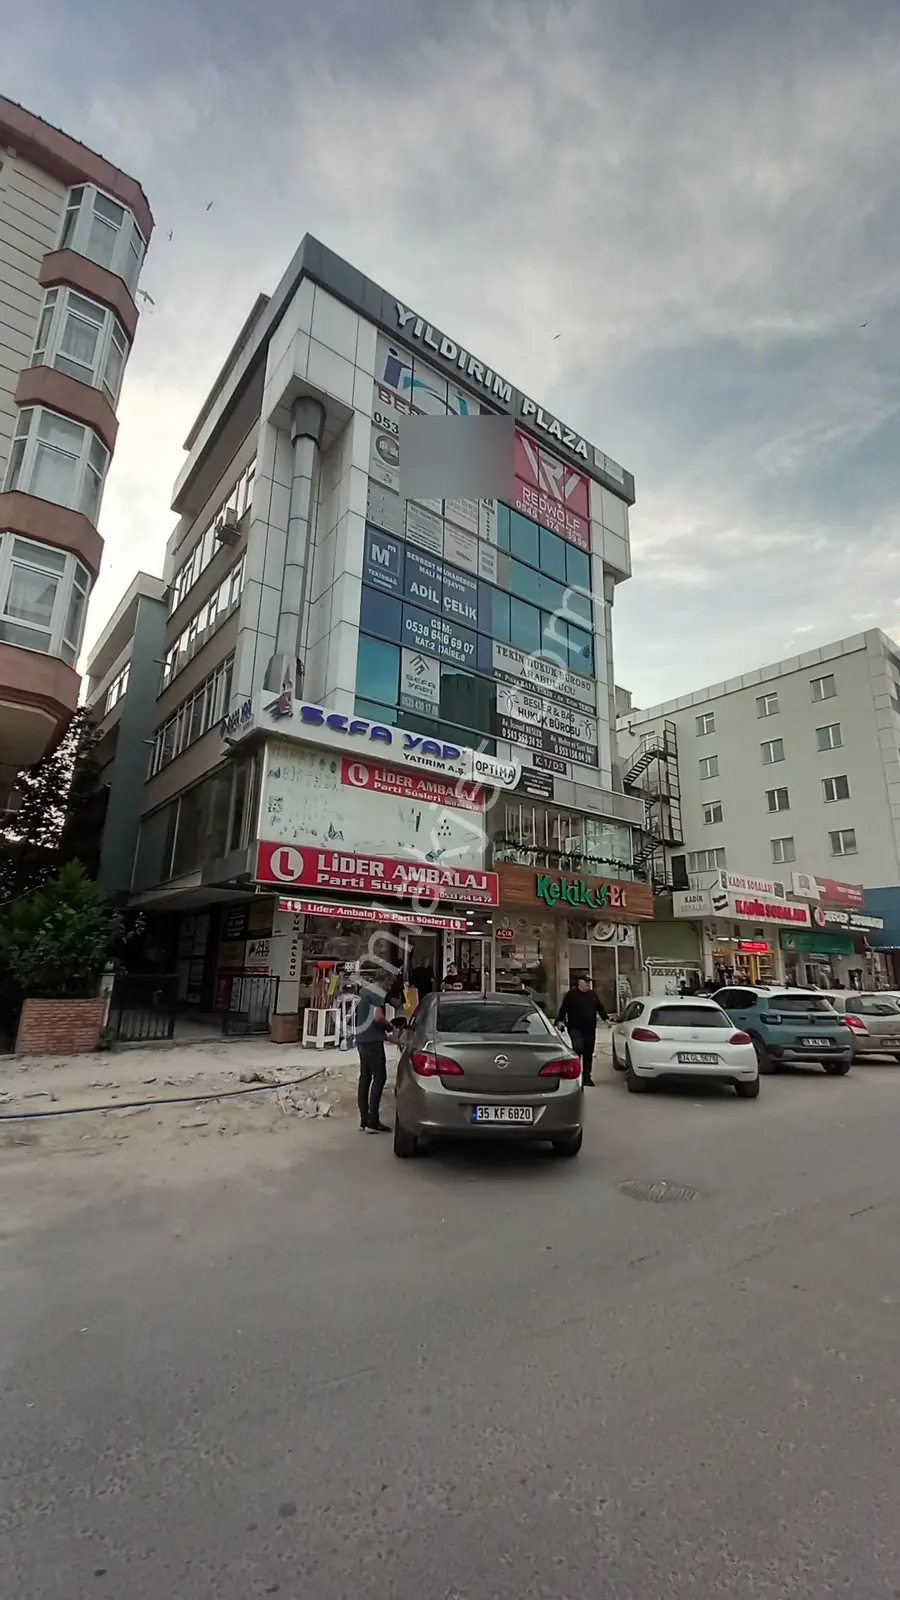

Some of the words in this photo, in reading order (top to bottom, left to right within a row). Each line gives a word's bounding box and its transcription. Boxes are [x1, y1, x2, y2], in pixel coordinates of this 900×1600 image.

[396, 302, 513, 403] YILDIRIM
[522, 398, 589, 460] PLAZA
[522, 487, 581, 531] REDWOLF
[410, 581, 440, 605] ADİL
[443, 596, 477, 621] ÇELİK
[405, 619, 430, 637] 0538
[451, 637, 462, 650] 69
[463, 642, 475, 655] 07
[430, 619, 453, 635] GSM:
[415, 635, 435, 651] KAT:2
[496, 644, 525, 664] TEKİN
[528, 659, 557, 678] HUKUK
[405, 673, 436, 690] SEFA
[520, 667, 576, 696] ARABULUCU
[523, 696, 552, 715] BESLER
[300, 705, 393, 746] SEFA
[517, 706, 548, 727] HUKUK
[549, 717, 581, 738] BÜROSU
[403, 753, 446, 770] YATIRIM
[374, 768, 413, 788] LİDER
[417, 780, 476, 802] AMBALAJ
[374, 782, 402, 794] Parti
[316, 873, 364, 888] Parti
[317, 853, 385, 878] LİDER
[392, 864, 488, 890] AMBALAJ
[536, 873, 598, 908] Kekik
[610, 884, 628, 907] Et
[307, 904, 334, 914] Lider
[337, 907, 376, 919] Ambalaj
[391, 912, 415, 922] Parti
[478, 1107, 490, 1119] 35
[494, 1107, 506, 1120] KF
[508, 1108, 531, 1120] 6820
